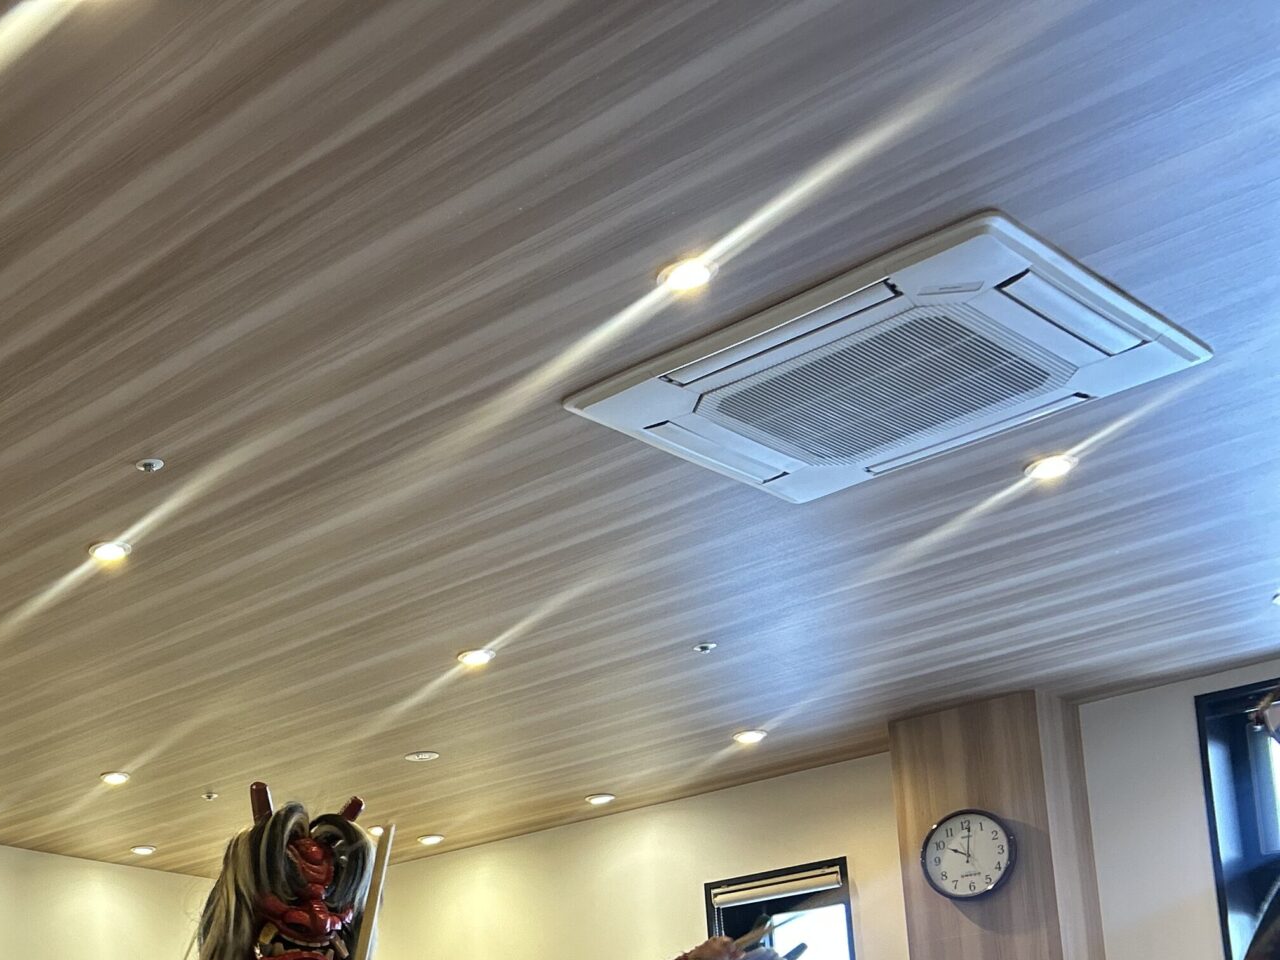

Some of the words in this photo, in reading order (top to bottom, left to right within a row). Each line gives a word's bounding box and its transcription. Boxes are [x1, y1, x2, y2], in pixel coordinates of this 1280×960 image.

[960, 820, 971, 832] 12
[979, 822, 984, 831] 1
[945, 828, 953, 838] 11
[992, 830, 999, 840] 2
[935, 840, 945, 851] 10
[998, 844, 1005, 855] 3
[934, 856, 941, 866] 9
[995, 861, 1002, 872] 4
[941, 871, 948, 881] 8
[985, 875, 993, 885] 5
[952, 880, 958, 890] 7
[969, 882, 976, 893] 6
